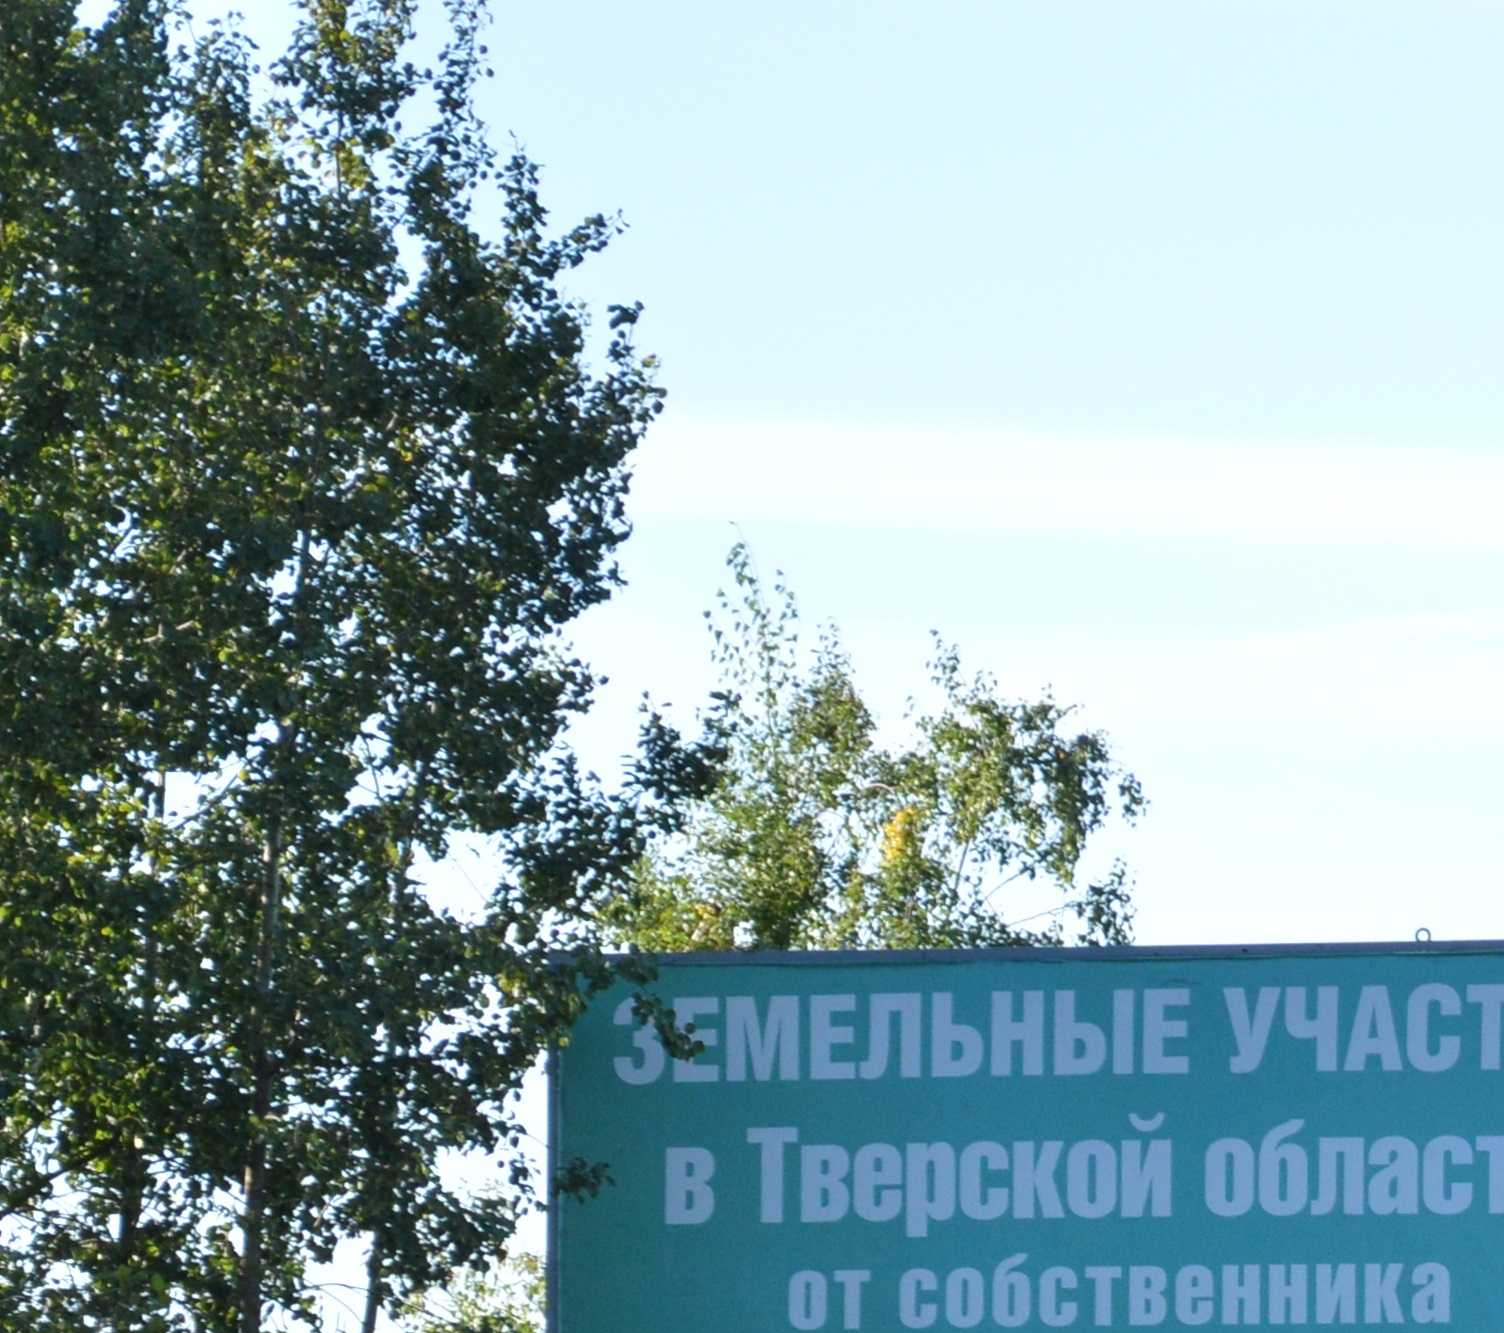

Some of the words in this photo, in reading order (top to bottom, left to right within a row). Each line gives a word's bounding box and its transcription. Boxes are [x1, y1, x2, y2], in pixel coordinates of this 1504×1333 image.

[613, 987, 1190, 1085] ЗЕМЕЛЬНЫЕ
[665, 1146, 714, 1225] в
[747, 1112, 1173, 1238] Тверской
[788, 1269, 870, 1331] от
[899, 1253, 1451, 1329] собственника
